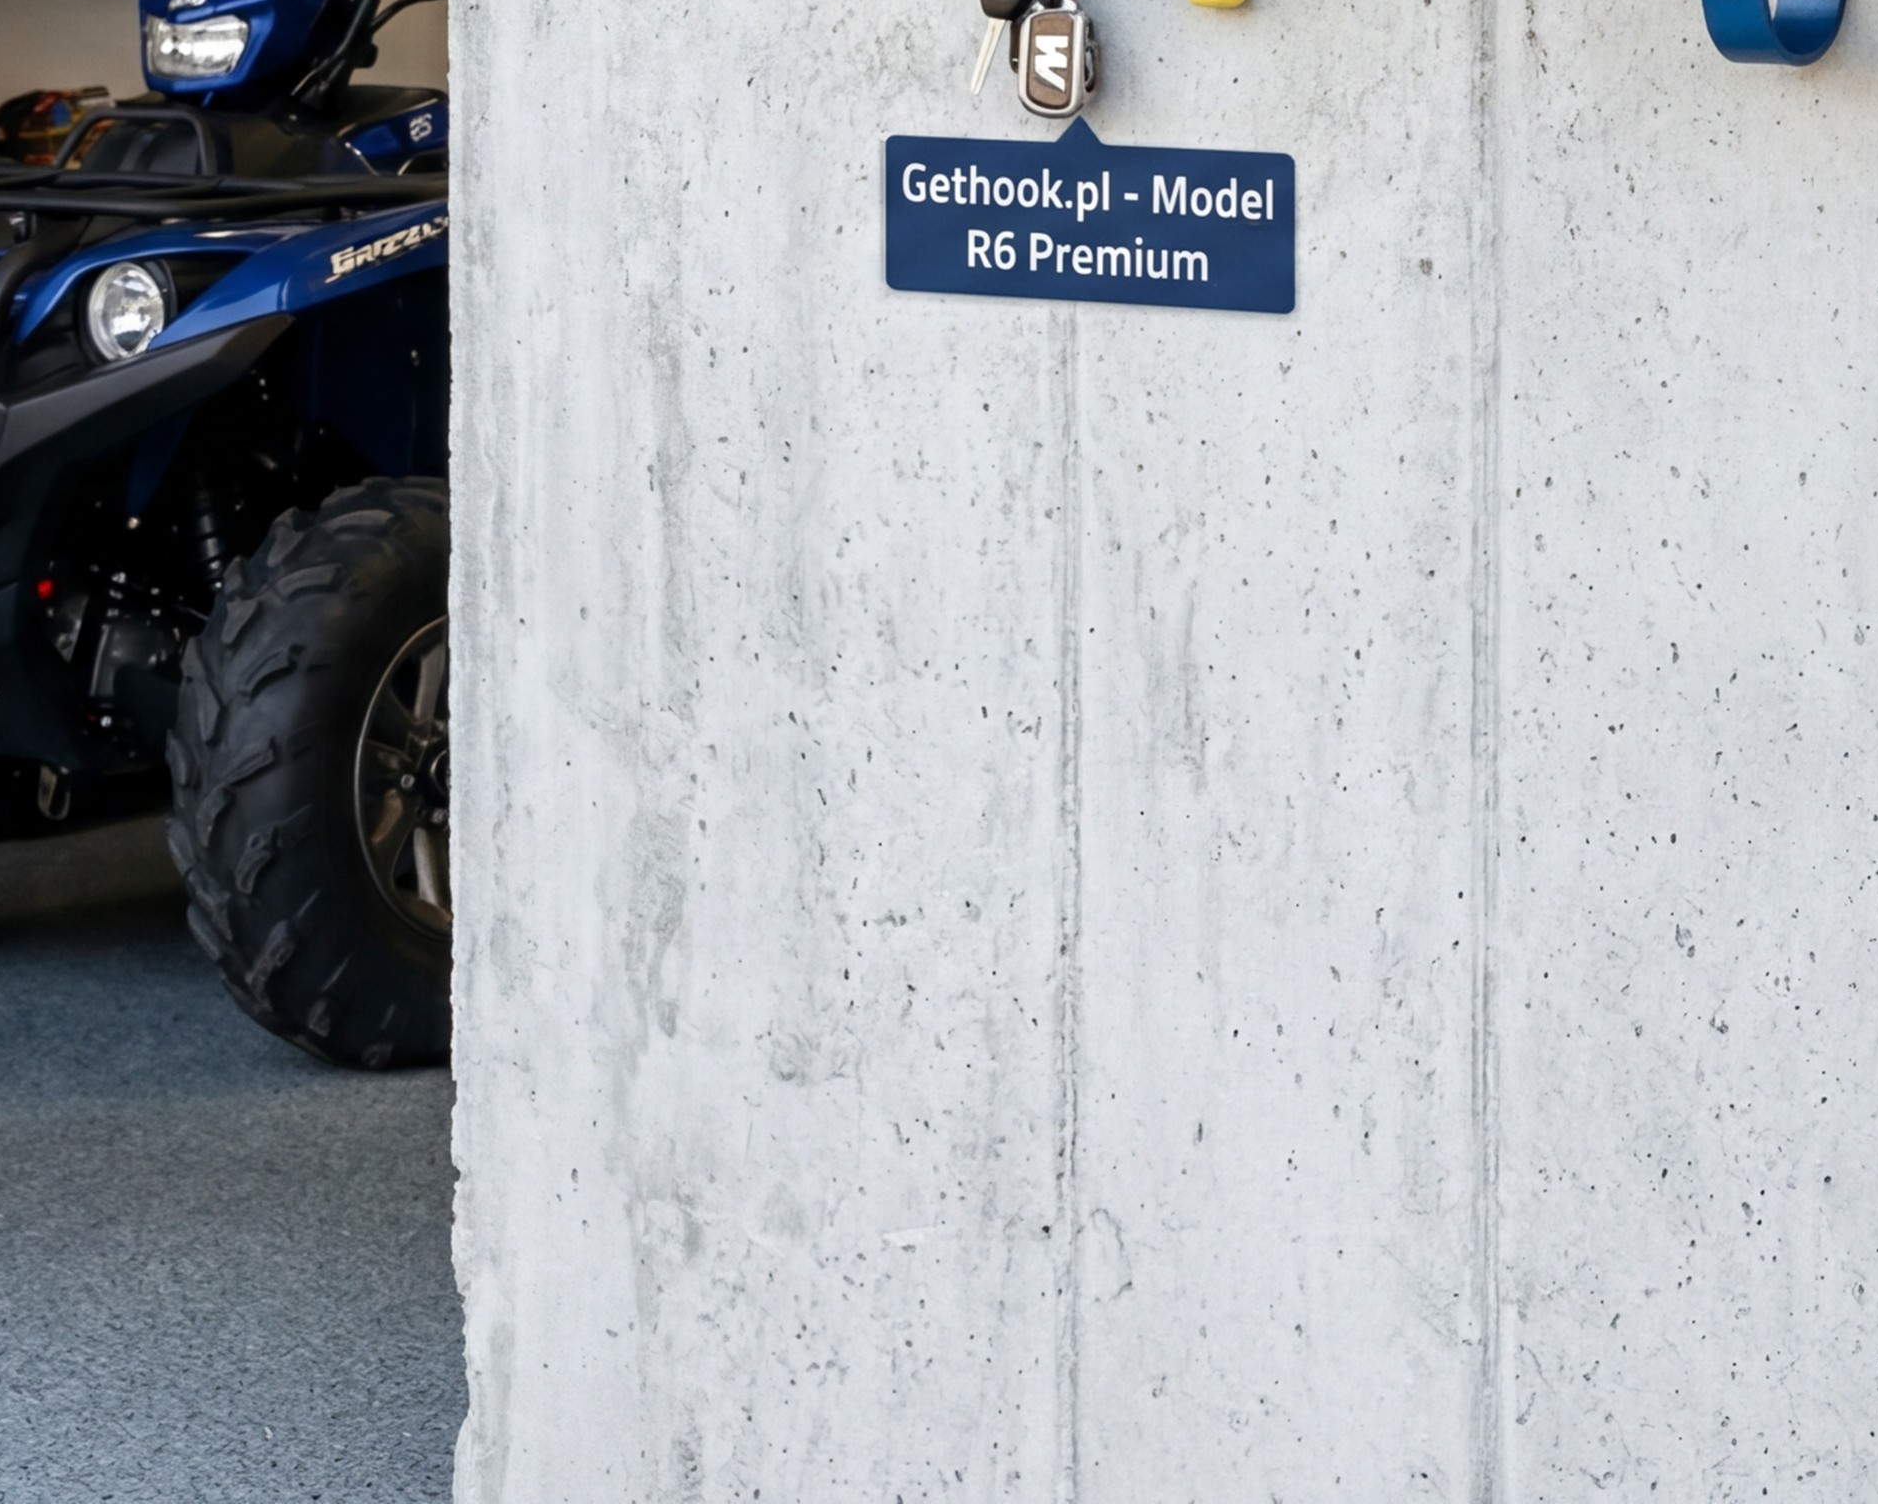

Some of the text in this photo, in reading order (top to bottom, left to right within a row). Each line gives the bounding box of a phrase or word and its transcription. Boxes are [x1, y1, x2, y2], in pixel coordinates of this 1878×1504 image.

[902, 162, 1110, 223] Gethook.pl
[1152, 174, 1274, 221] Model
[967, 229, 1209, 282] R6 Premium
